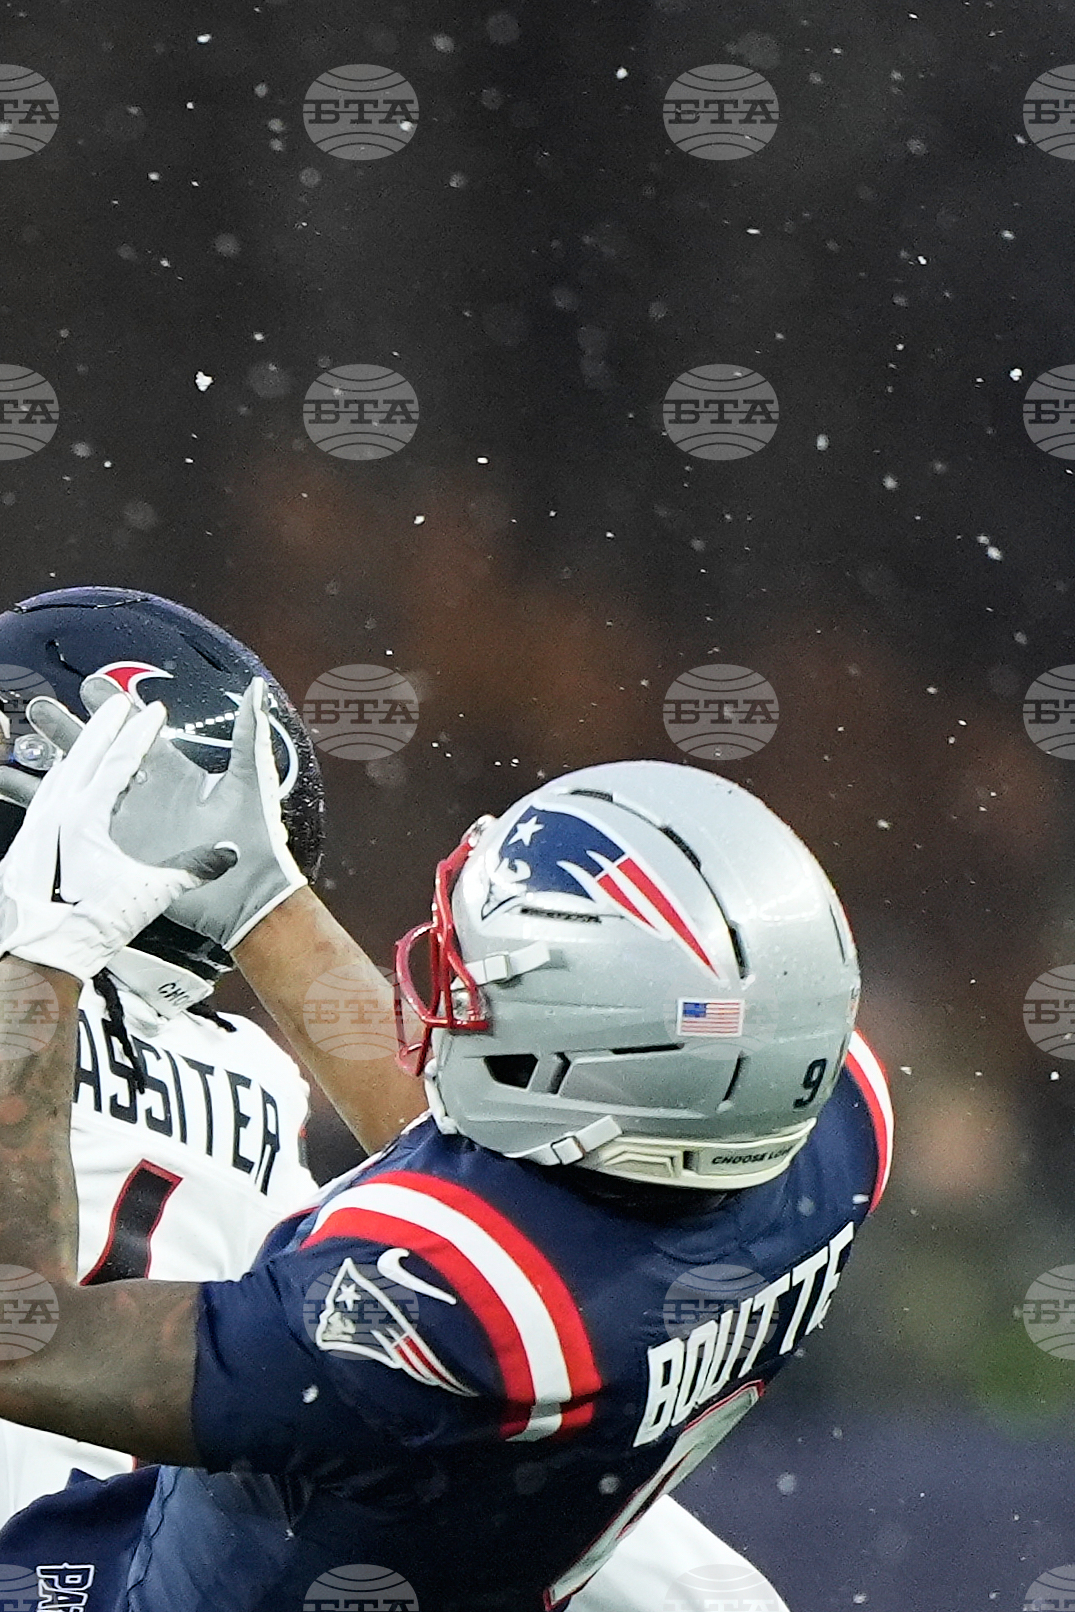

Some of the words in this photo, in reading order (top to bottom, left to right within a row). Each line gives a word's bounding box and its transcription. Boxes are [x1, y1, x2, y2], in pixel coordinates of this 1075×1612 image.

[74, 1008, 281, 1197] ASSITER
[792, 1057, 827, 1109] 9
[632, 1221, 855, 1448] BOUTTE
